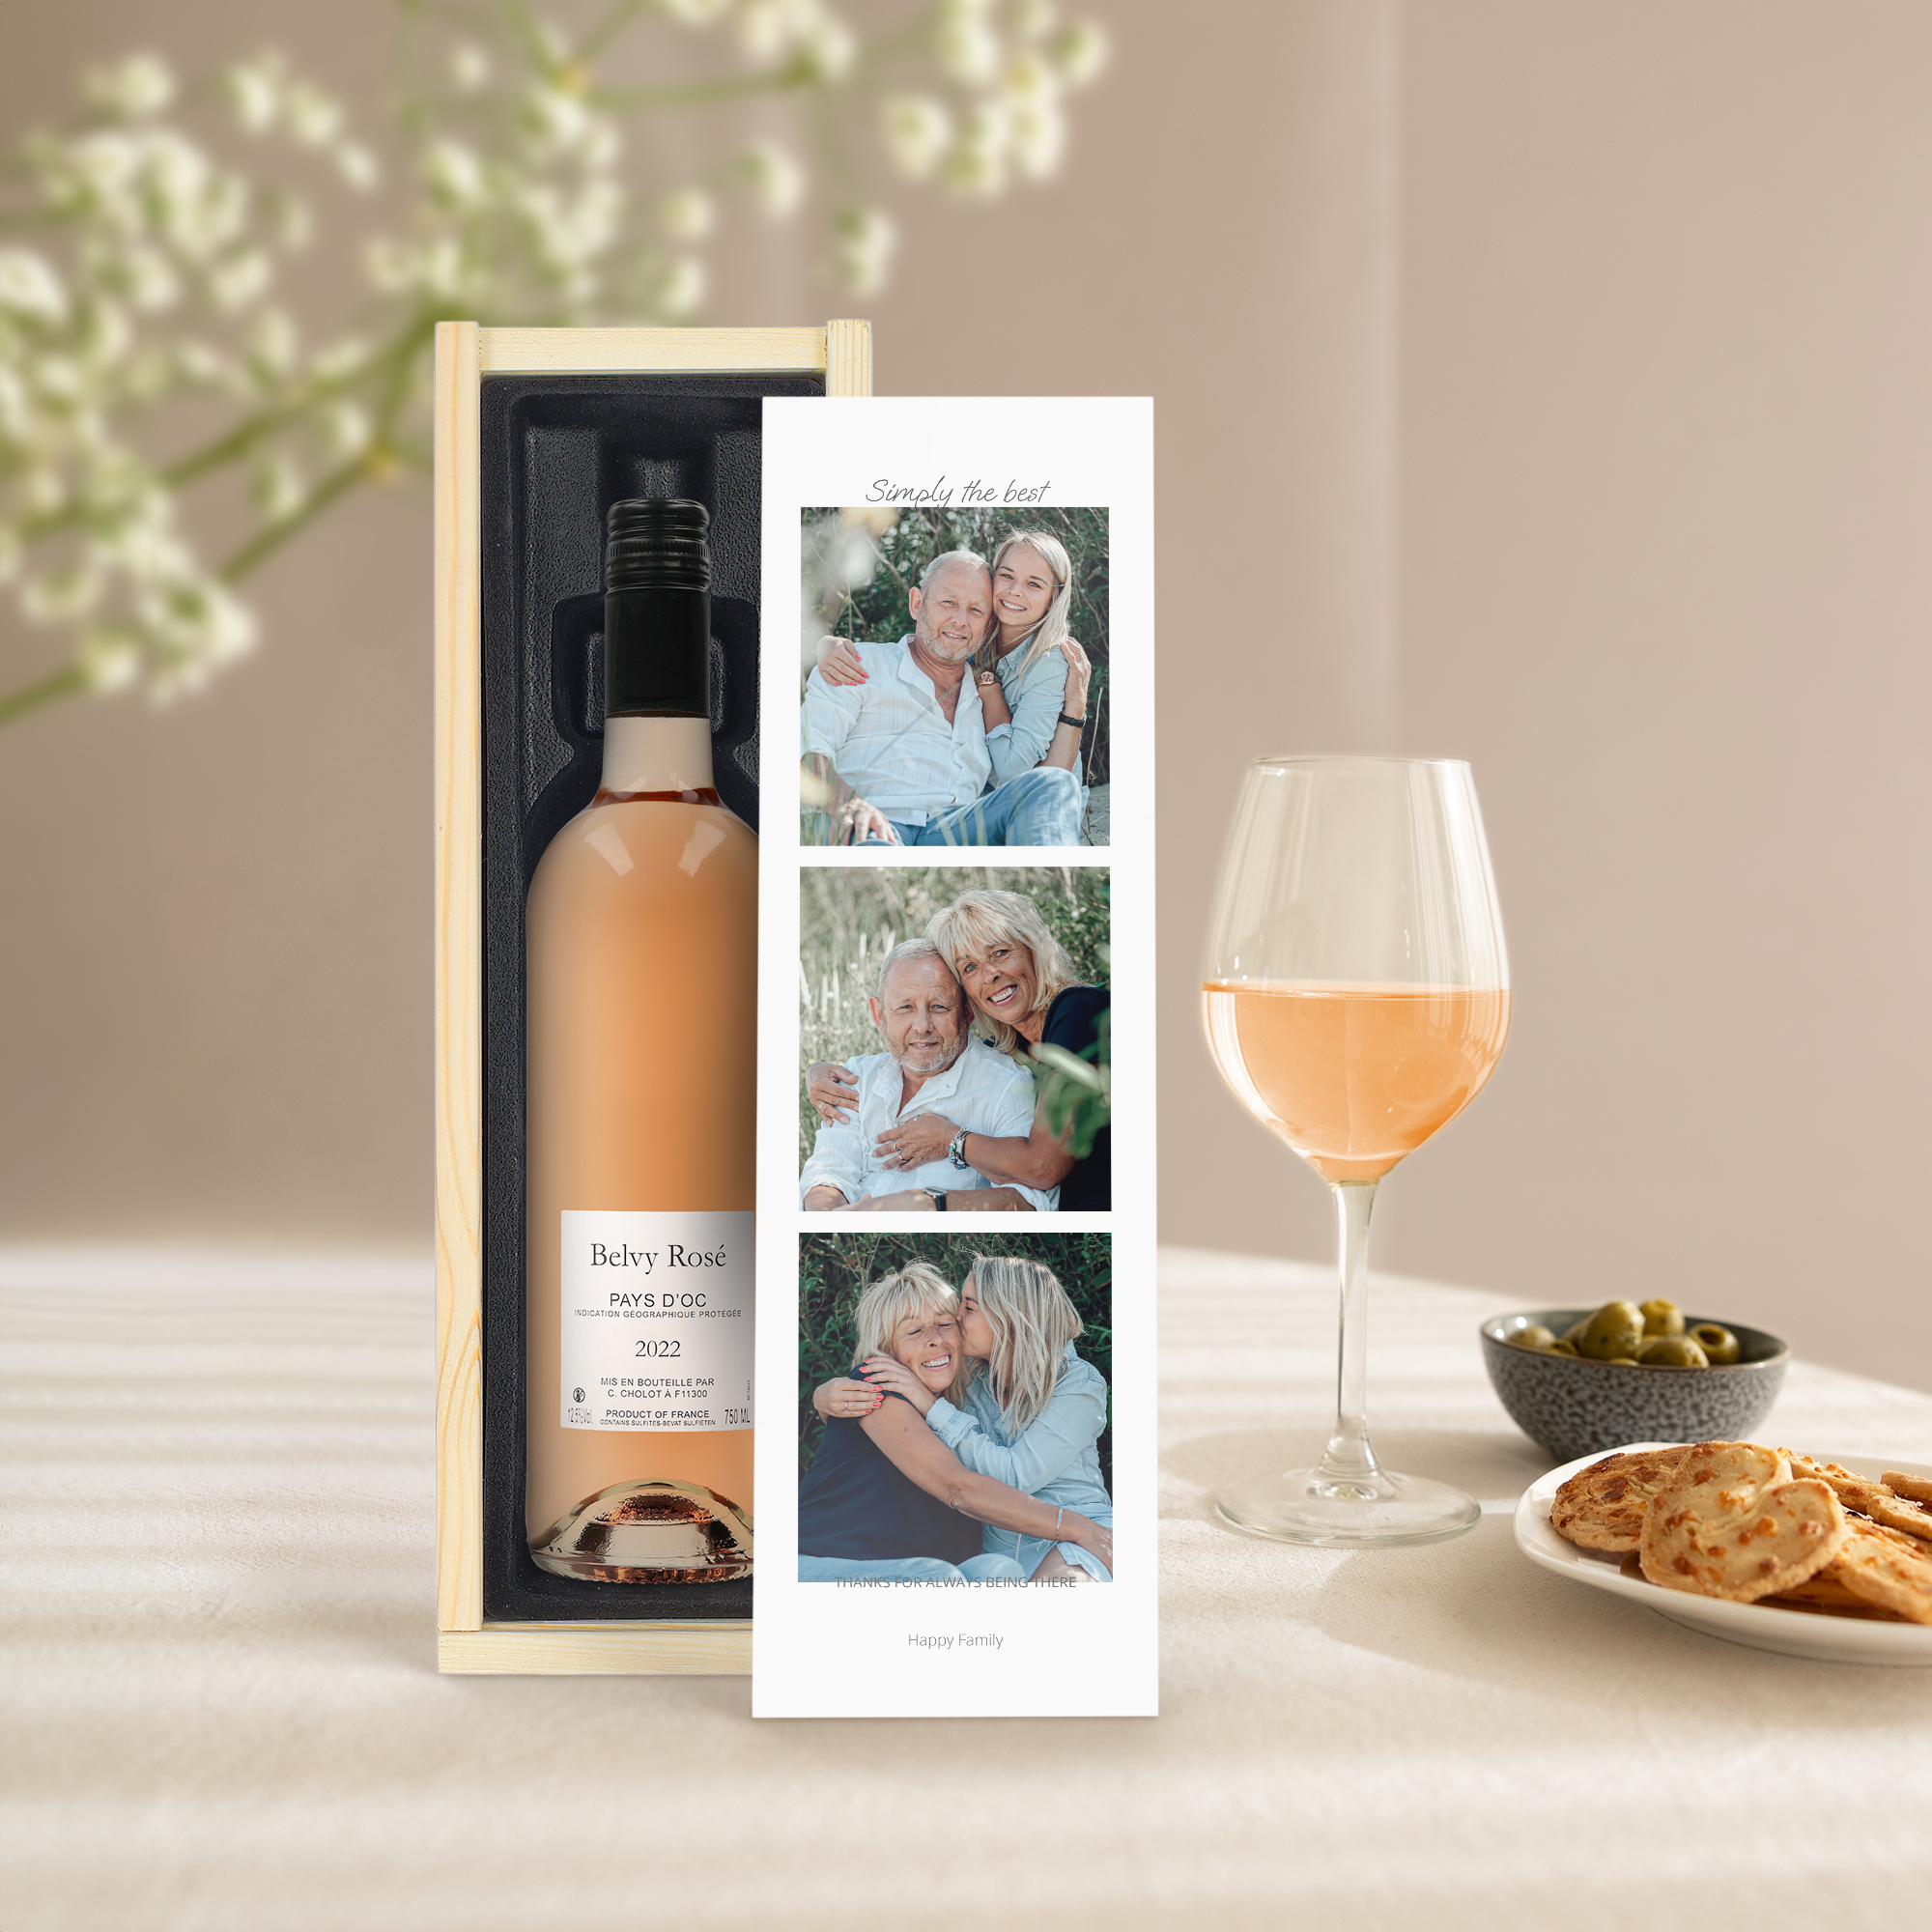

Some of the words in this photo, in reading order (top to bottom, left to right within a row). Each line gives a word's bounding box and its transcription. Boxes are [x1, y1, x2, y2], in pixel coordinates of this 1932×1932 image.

[961, 480, 998, 502] the
[1004, 479, 1051, 503] best
[590, 1243, 659, 1275] Belvy
[668, 1243, 726, 1267] Rosé
[610, 1293, 655, 1308] PAYS
[663, 1293, 707, 1308] D'OC
[574, 1309, 620, 1318] INDICATION
[623, 1309, 696, 1319] GÉOGRAPHIQUE
[698, 1309, 742, 1318] PROTÉGÉE
[635, 1340, 681, 1357] 2022
[601, 1378, 618, 1386] MIS
[620, 1378, 634, 1386] EN
[638, 1378, 693, 1387] BOUTEILLE
[696, 1378, 715, 1386] PAR
[608, 1389, 617, 1398] C.
[620, 1389, 662, 1399] CHOLOT
[606, 1409, 652, 1419] PRODUCT
[655, 1410, 668, 1419] OF
[671, 1410, 710, 1419] FRANCE
[724, 1408, 739, 1425] 750
[740, 1408, 751, 1424] ML
[834, 1576, 891, 1588] THANKS
[895, 1576, 923, 1588] FOR
[925, 1576, 981, 1588] ALWAYS
[985, 1576, 1029, 1588] BEING
[1032, 1576, 1077, 1588] THERE
[908, 1634, 954, 1649] Happy
[958, 1634, 1004, 1649] Family
